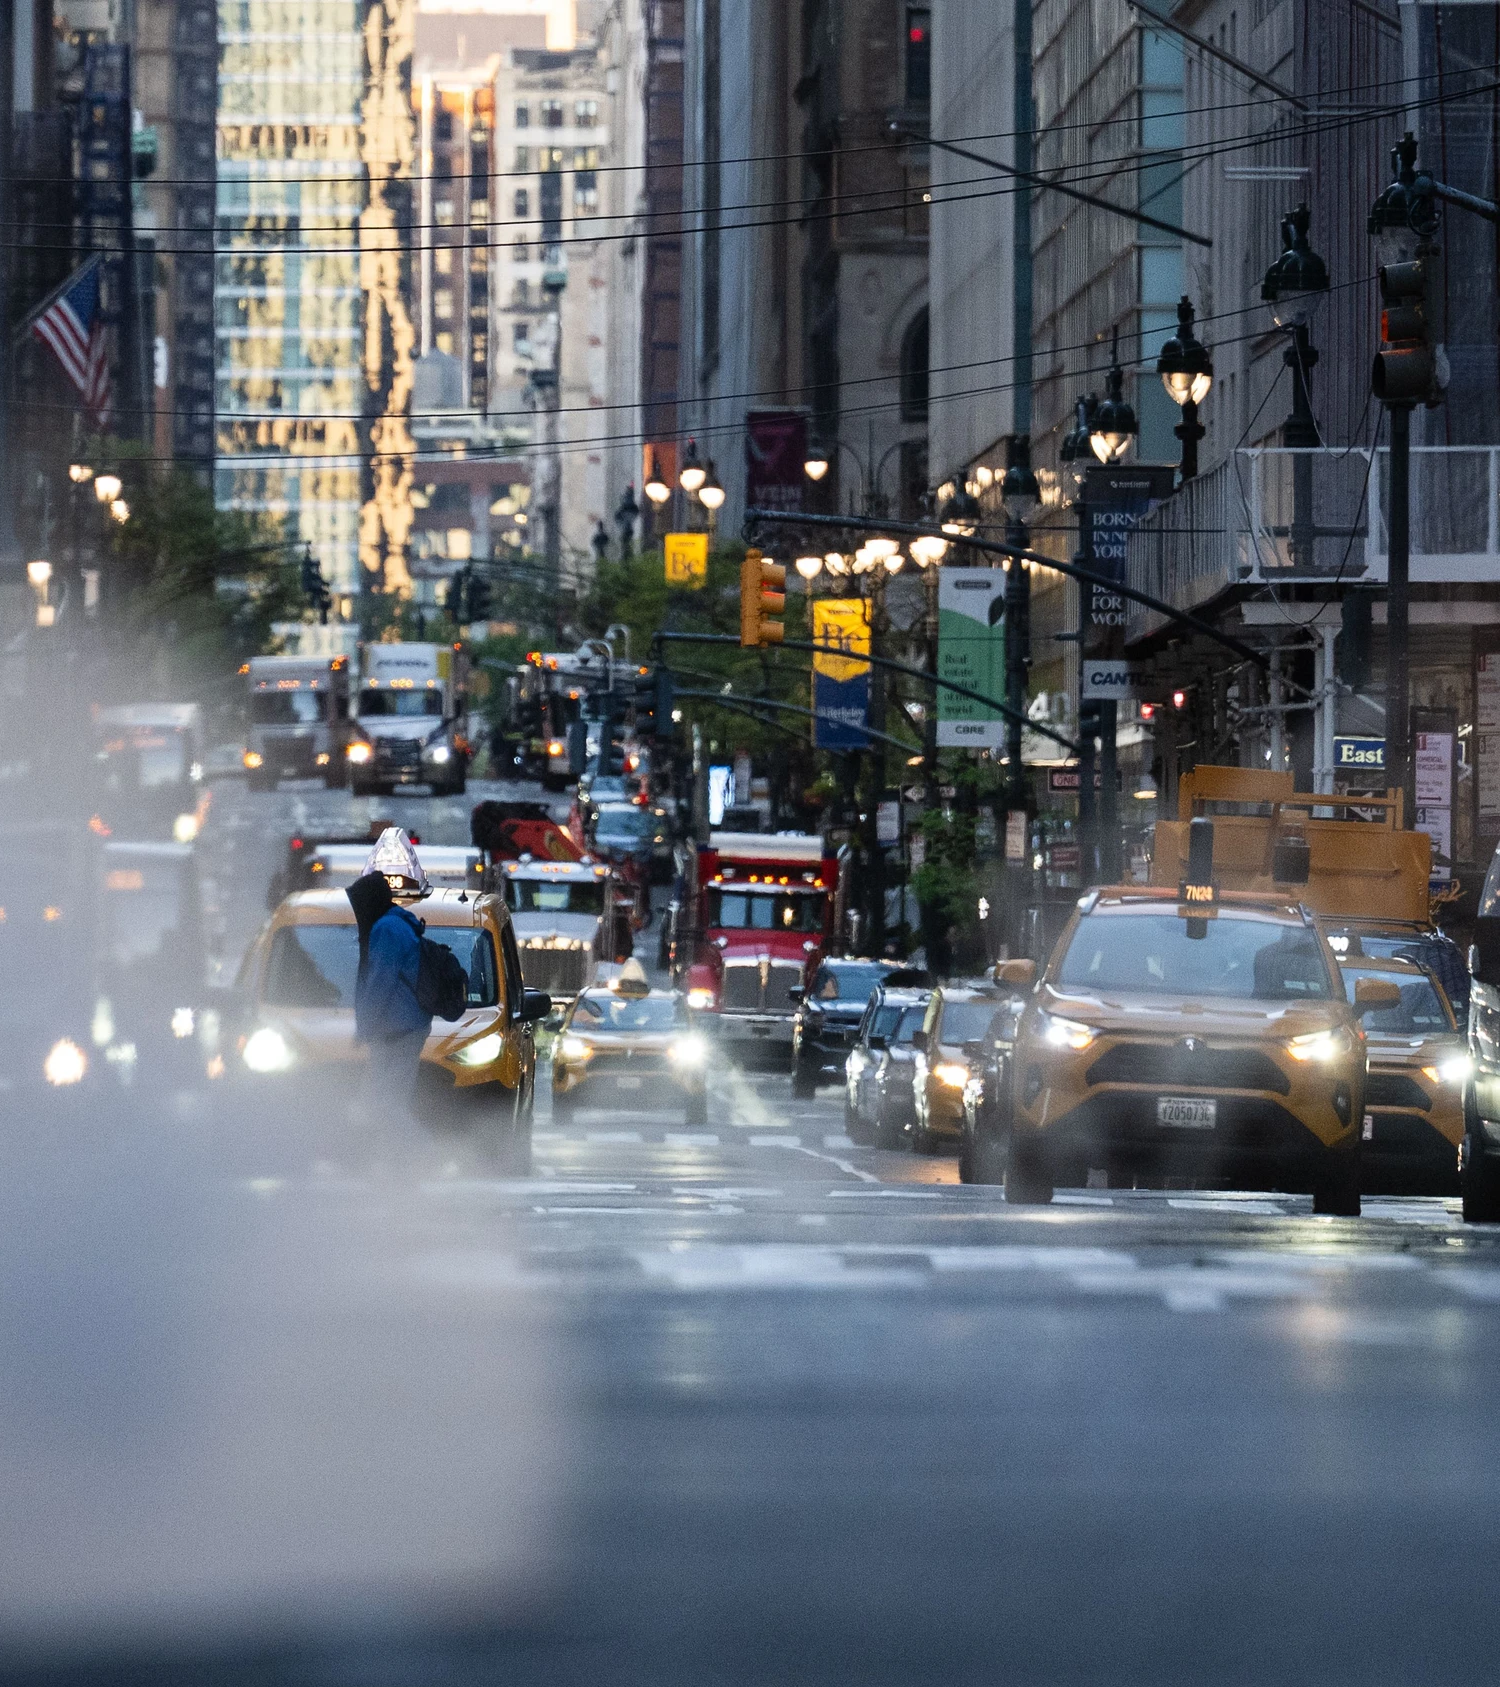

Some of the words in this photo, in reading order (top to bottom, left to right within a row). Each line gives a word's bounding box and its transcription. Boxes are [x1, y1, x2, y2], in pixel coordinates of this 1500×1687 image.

[1093, 513, 1136, 526] BORN
[1093, 531, 1109, 542] IN
[1092, 597, 1122, 610] FOR
[955, 725, 985, 735] CBRE
[1340, 744, 1384, 763] East
[1056, 775, 1078, 785] ONE
